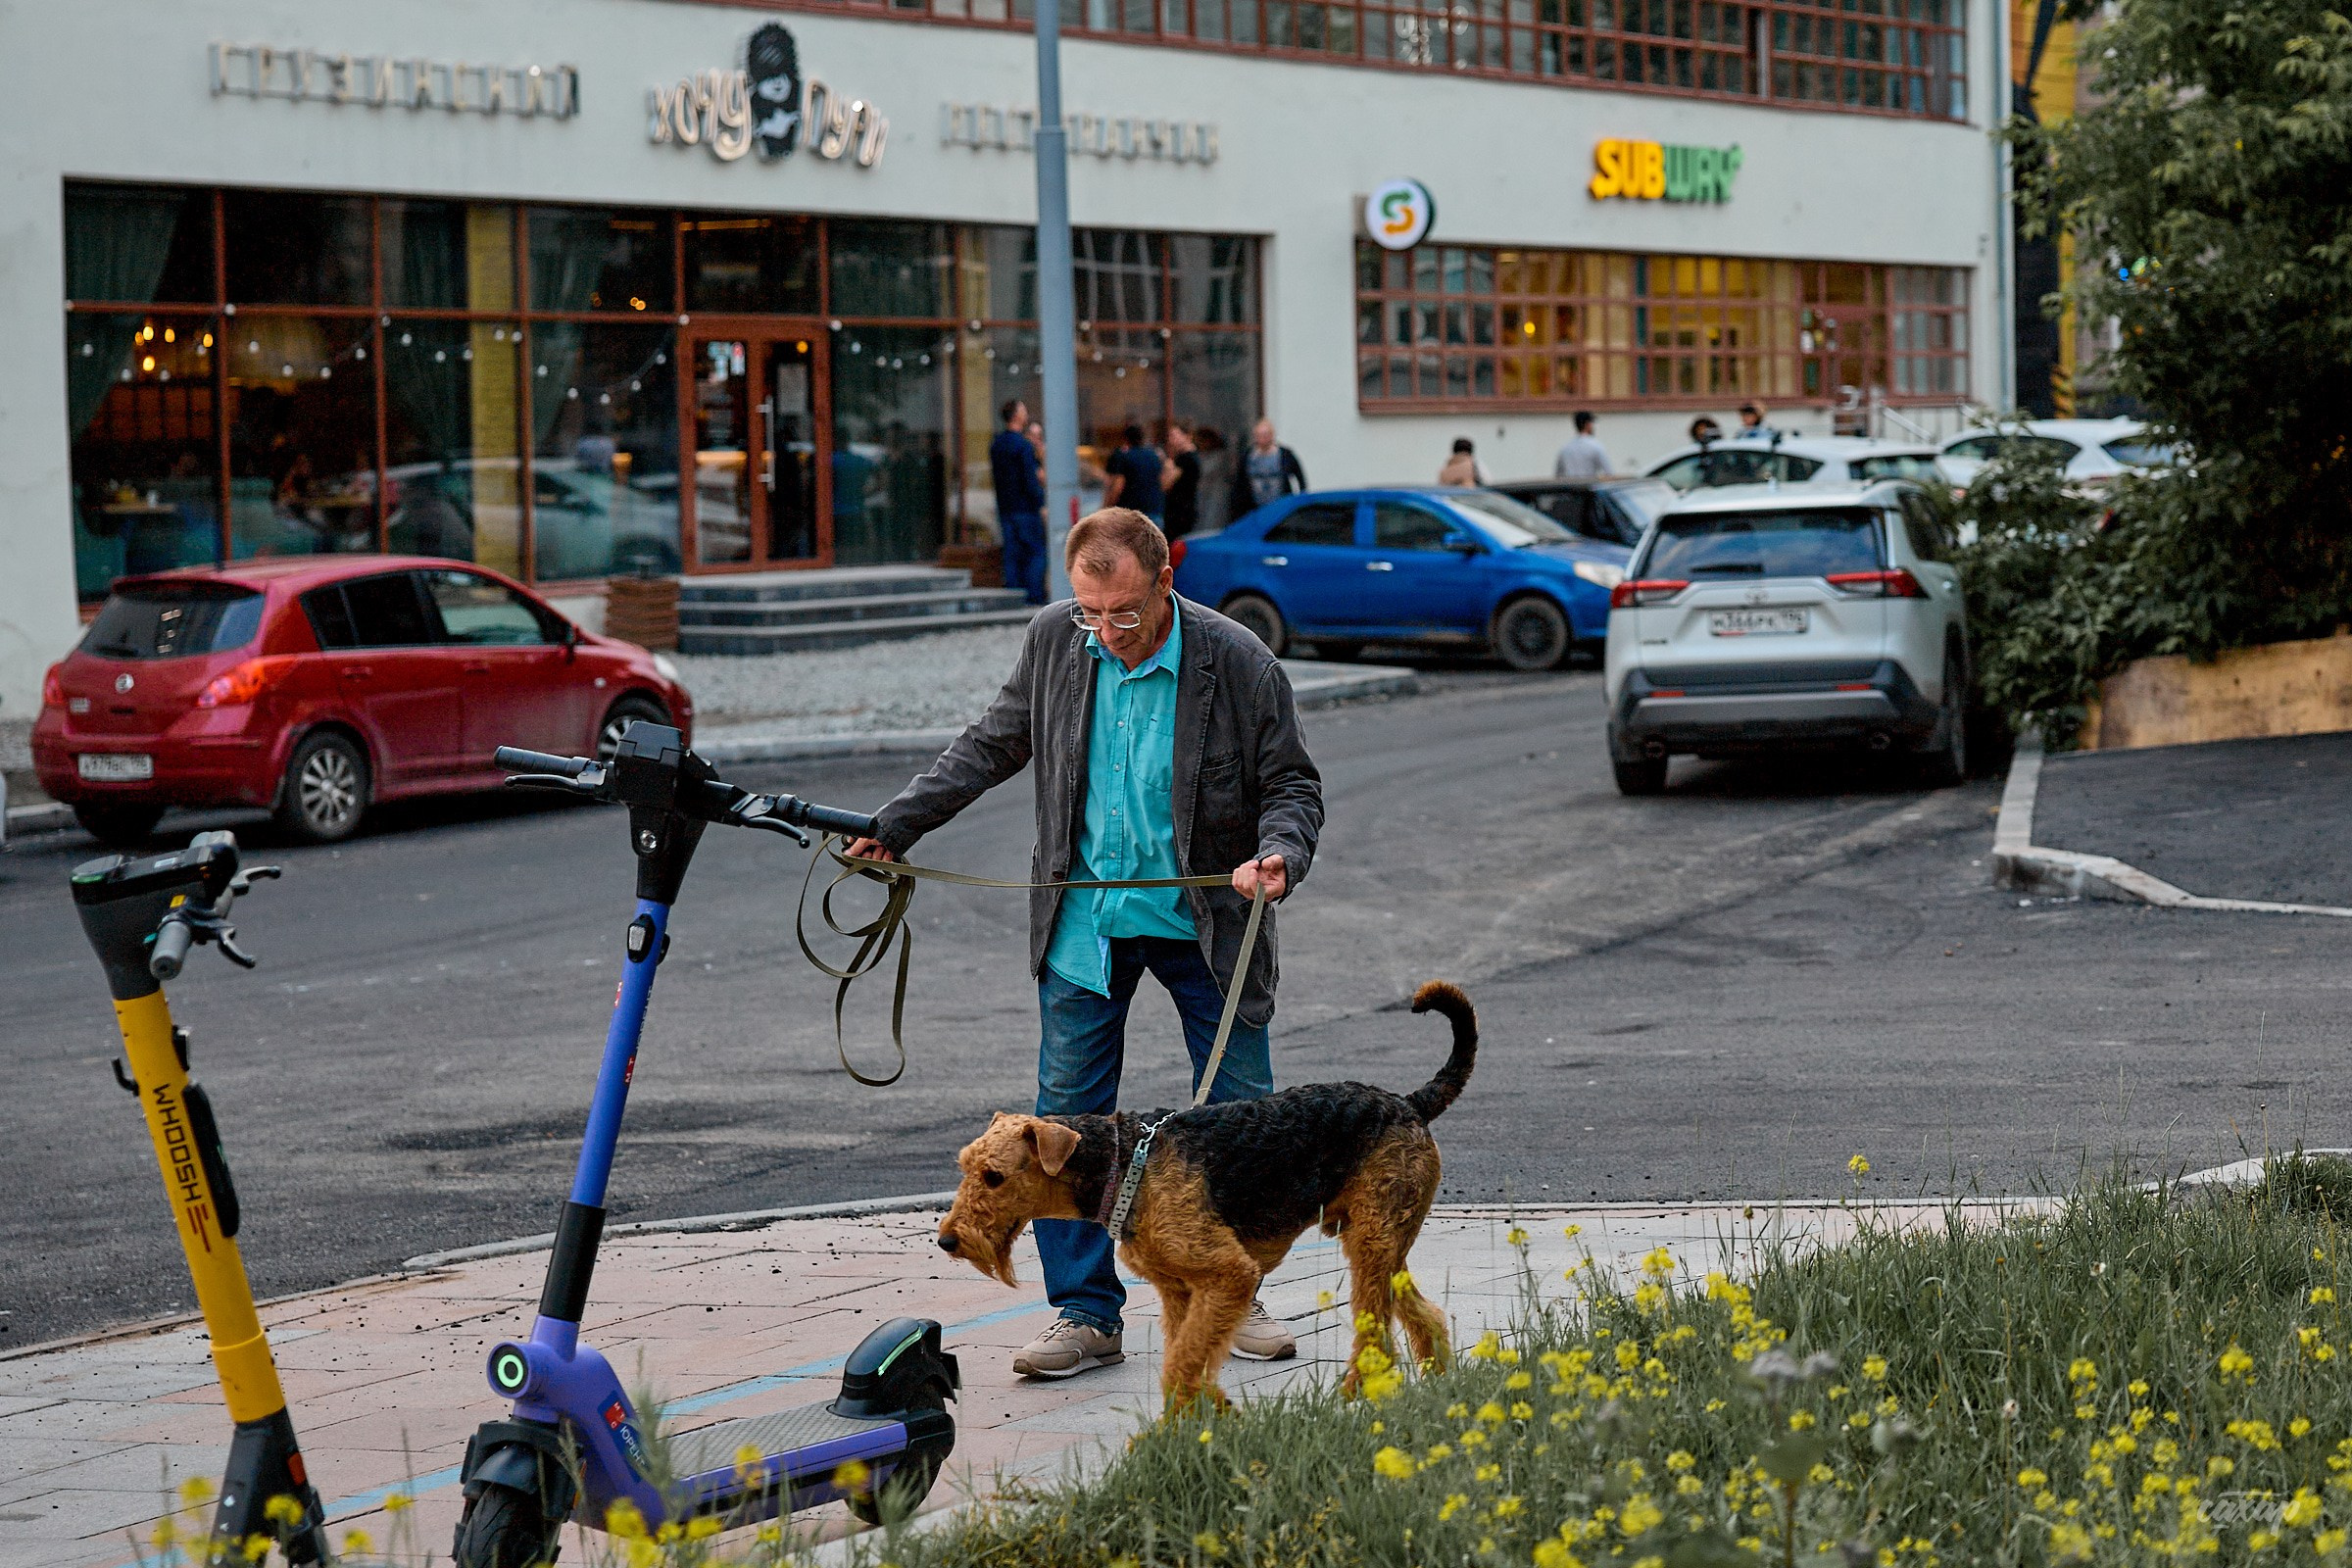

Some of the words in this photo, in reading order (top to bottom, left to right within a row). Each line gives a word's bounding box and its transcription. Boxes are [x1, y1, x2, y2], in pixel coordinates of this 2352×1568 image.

[940, 101, 1220, 165] РЕСТРАНЧИК
[1589, 137, 1744, 204] SUBWAY
[152, 1082, 203, 1203] WHOOSH
